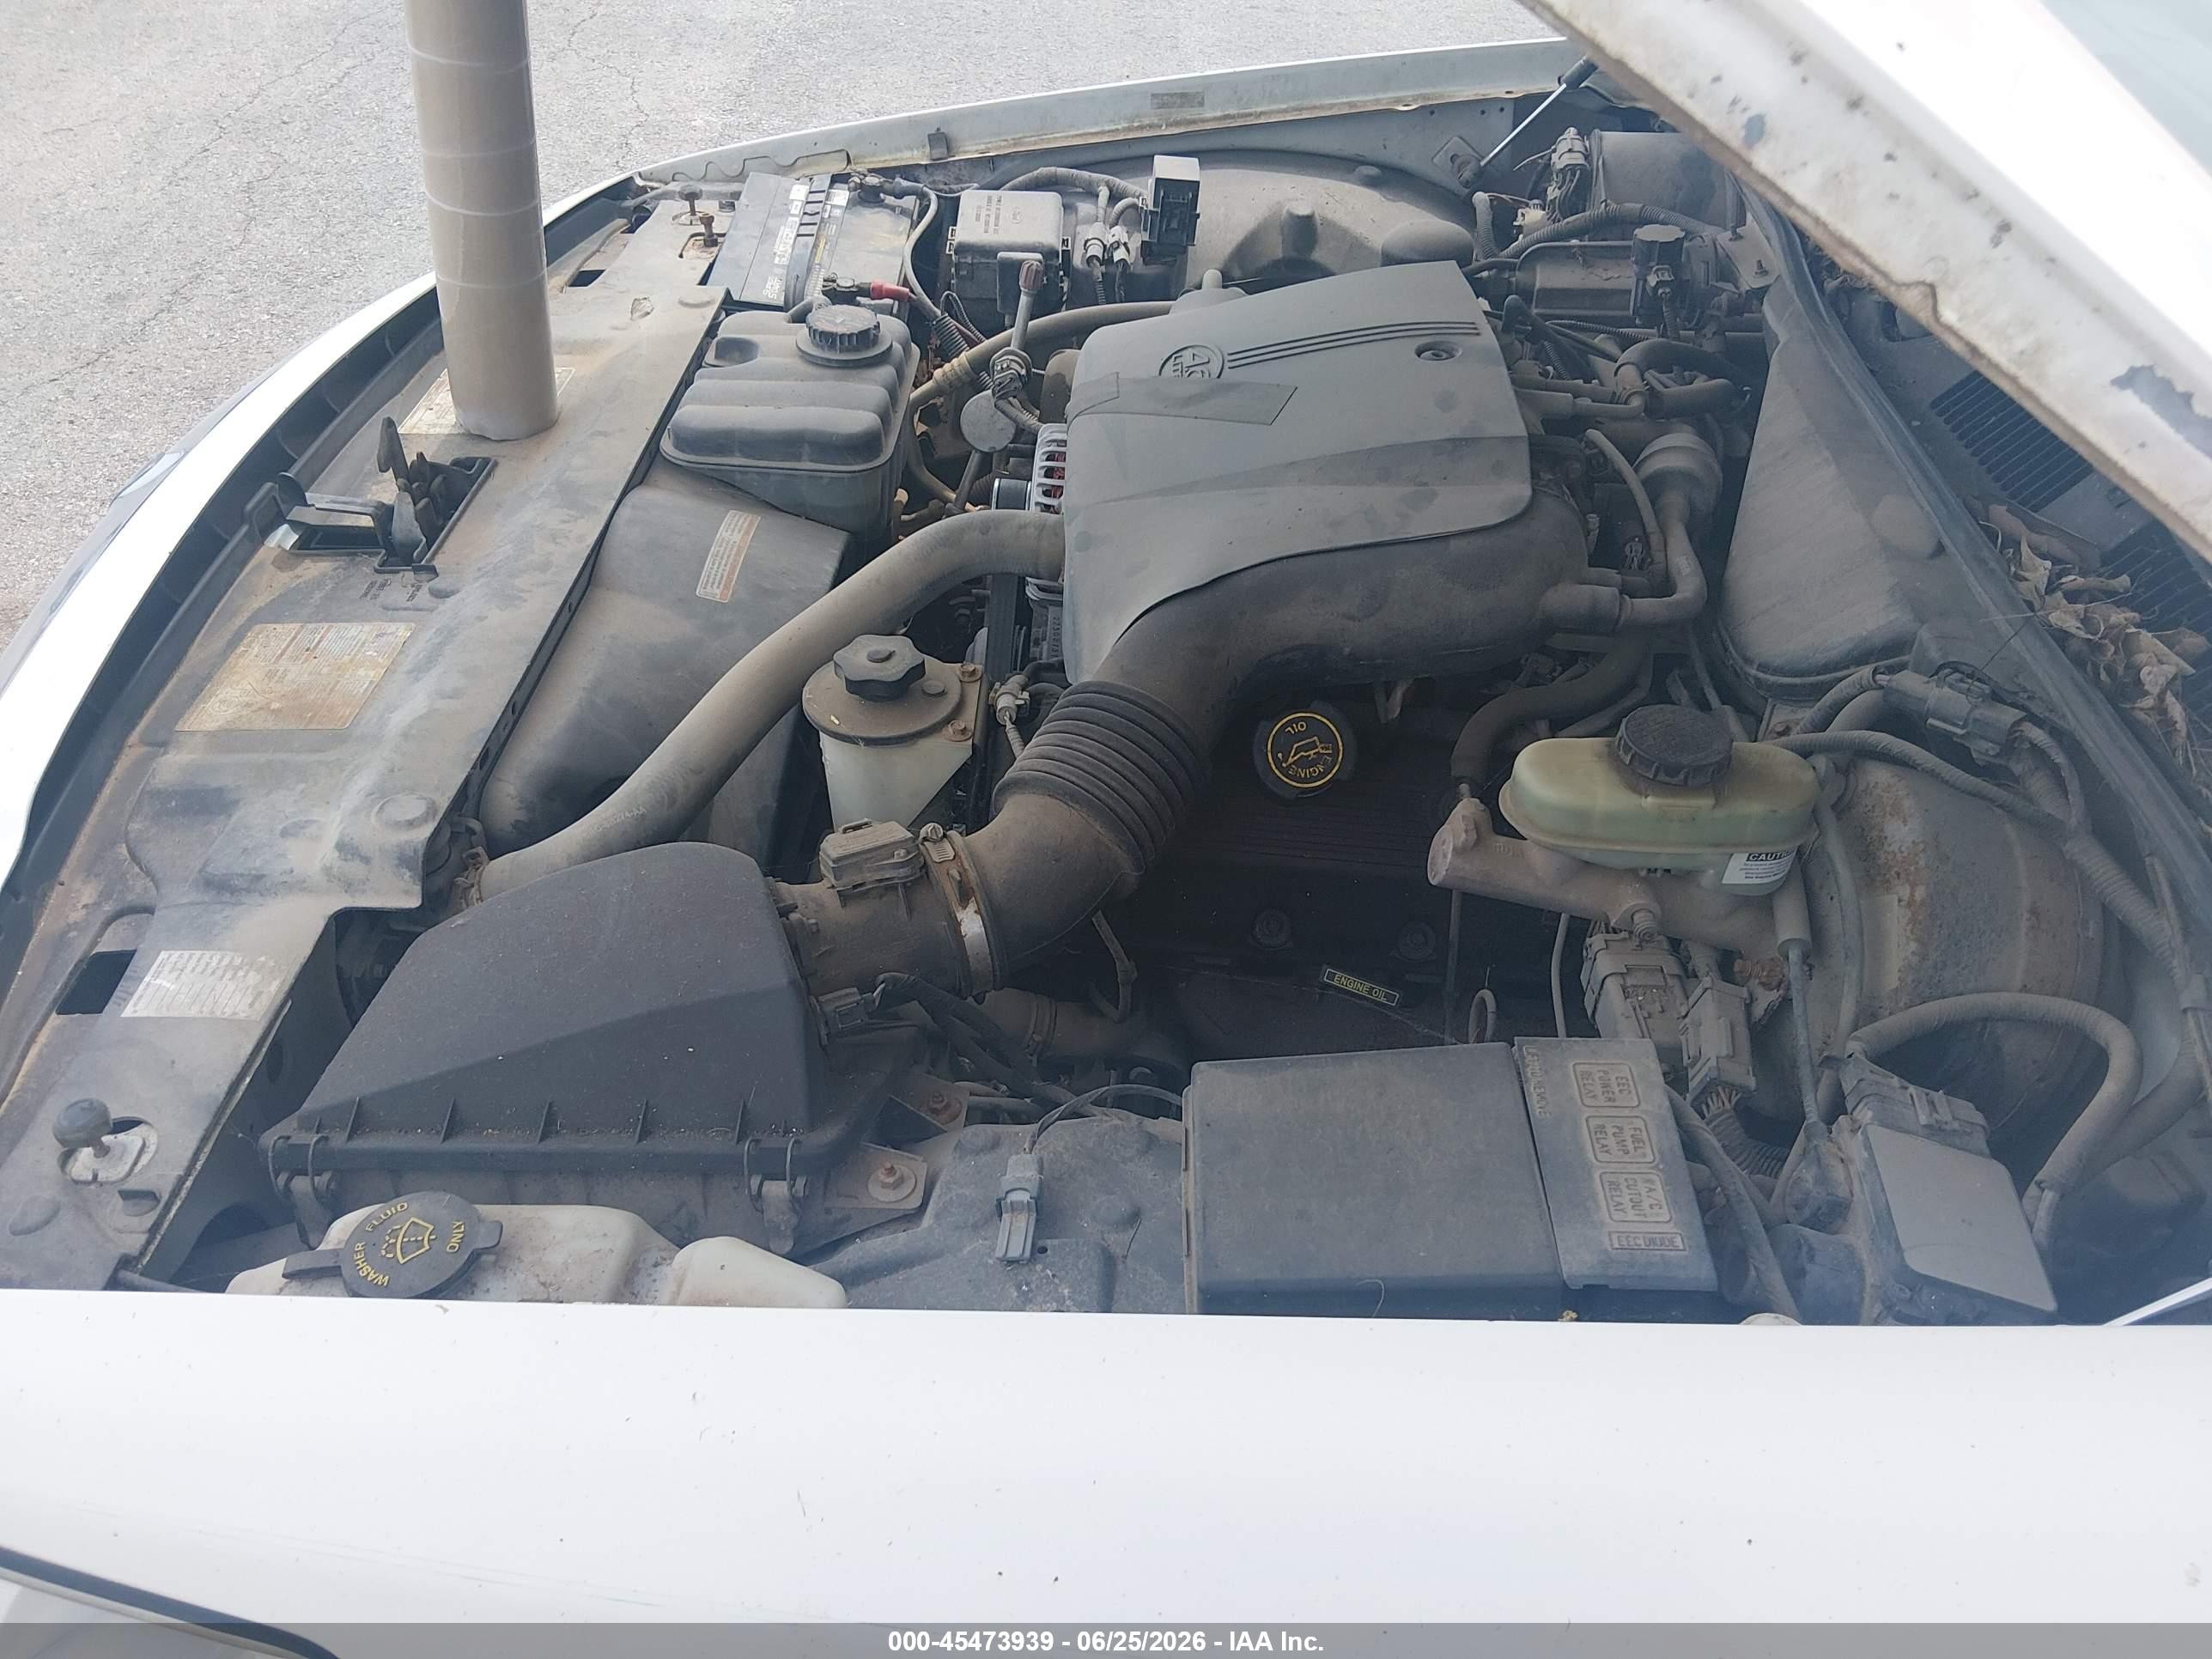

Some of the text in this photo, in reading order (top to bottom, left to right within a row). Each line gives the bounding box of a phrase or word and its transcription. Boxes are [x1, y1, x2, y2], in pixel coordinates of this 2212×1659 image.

[1285, 721, 1306, 734] OIL
[1288, 755, 1333, 778] ENGINE
[1334, 974, 1388, 1001] ENGINE OIL
[1580, 1070, 1597, 1101] RELAY
[1598, 1069, 1616, 1103] POWER
[1615, 1075, 1631, 1095] EEC
[1593, 1123, 1613, 1156] RELAY
[1612, 1125, 1630, 1155] PUMP
[1607, 1180, 1627, 1214] RELAY
[1624, 1177, 1647, 1218] CUTOUT
[353, 1201, 408, 1286] WASHER FLUID
[446, 1219, 466, 1253] ONLY
[1617, 1235, 1641, 1247] EEC
